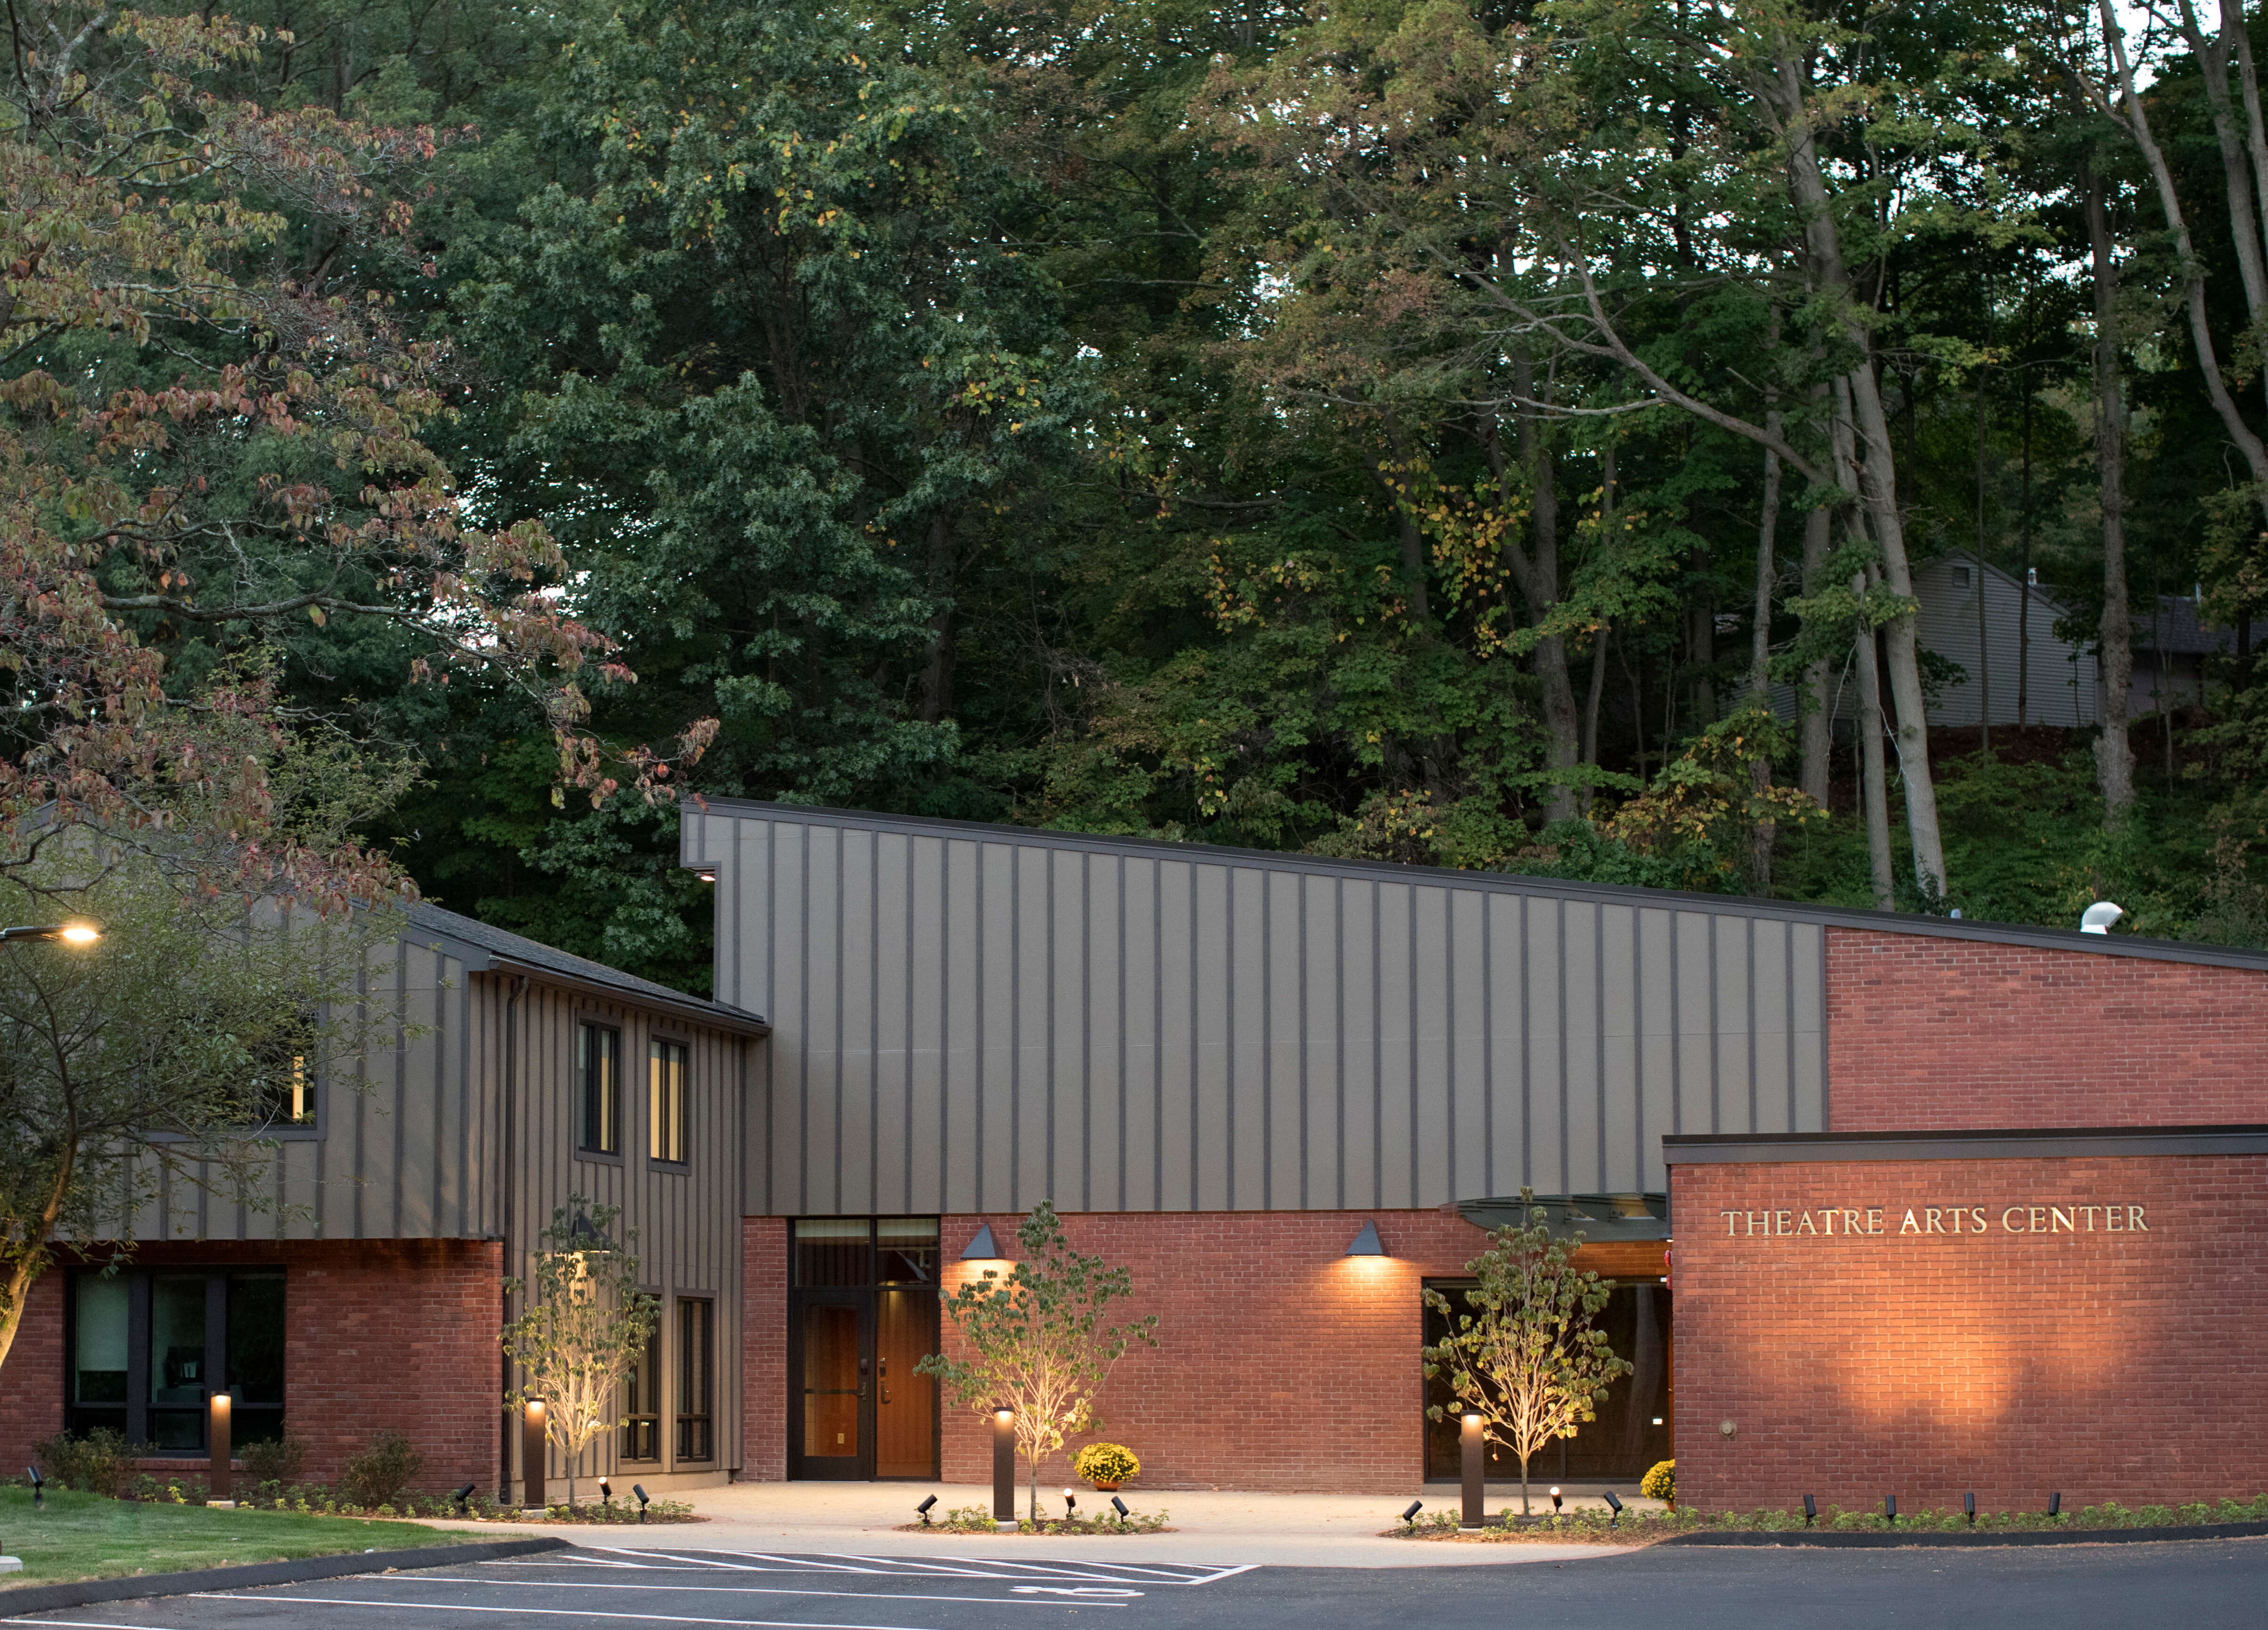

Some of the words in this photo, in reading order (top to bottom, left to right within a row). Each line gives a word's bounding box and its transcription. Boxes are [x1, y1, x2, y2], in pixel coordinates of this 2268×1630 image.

[1720, 1209, 1884, 1236] THEATRE
[1899, 1207, 1987, 1234] ARTS
[2002, 1205, 2150, 1233] CENTER
